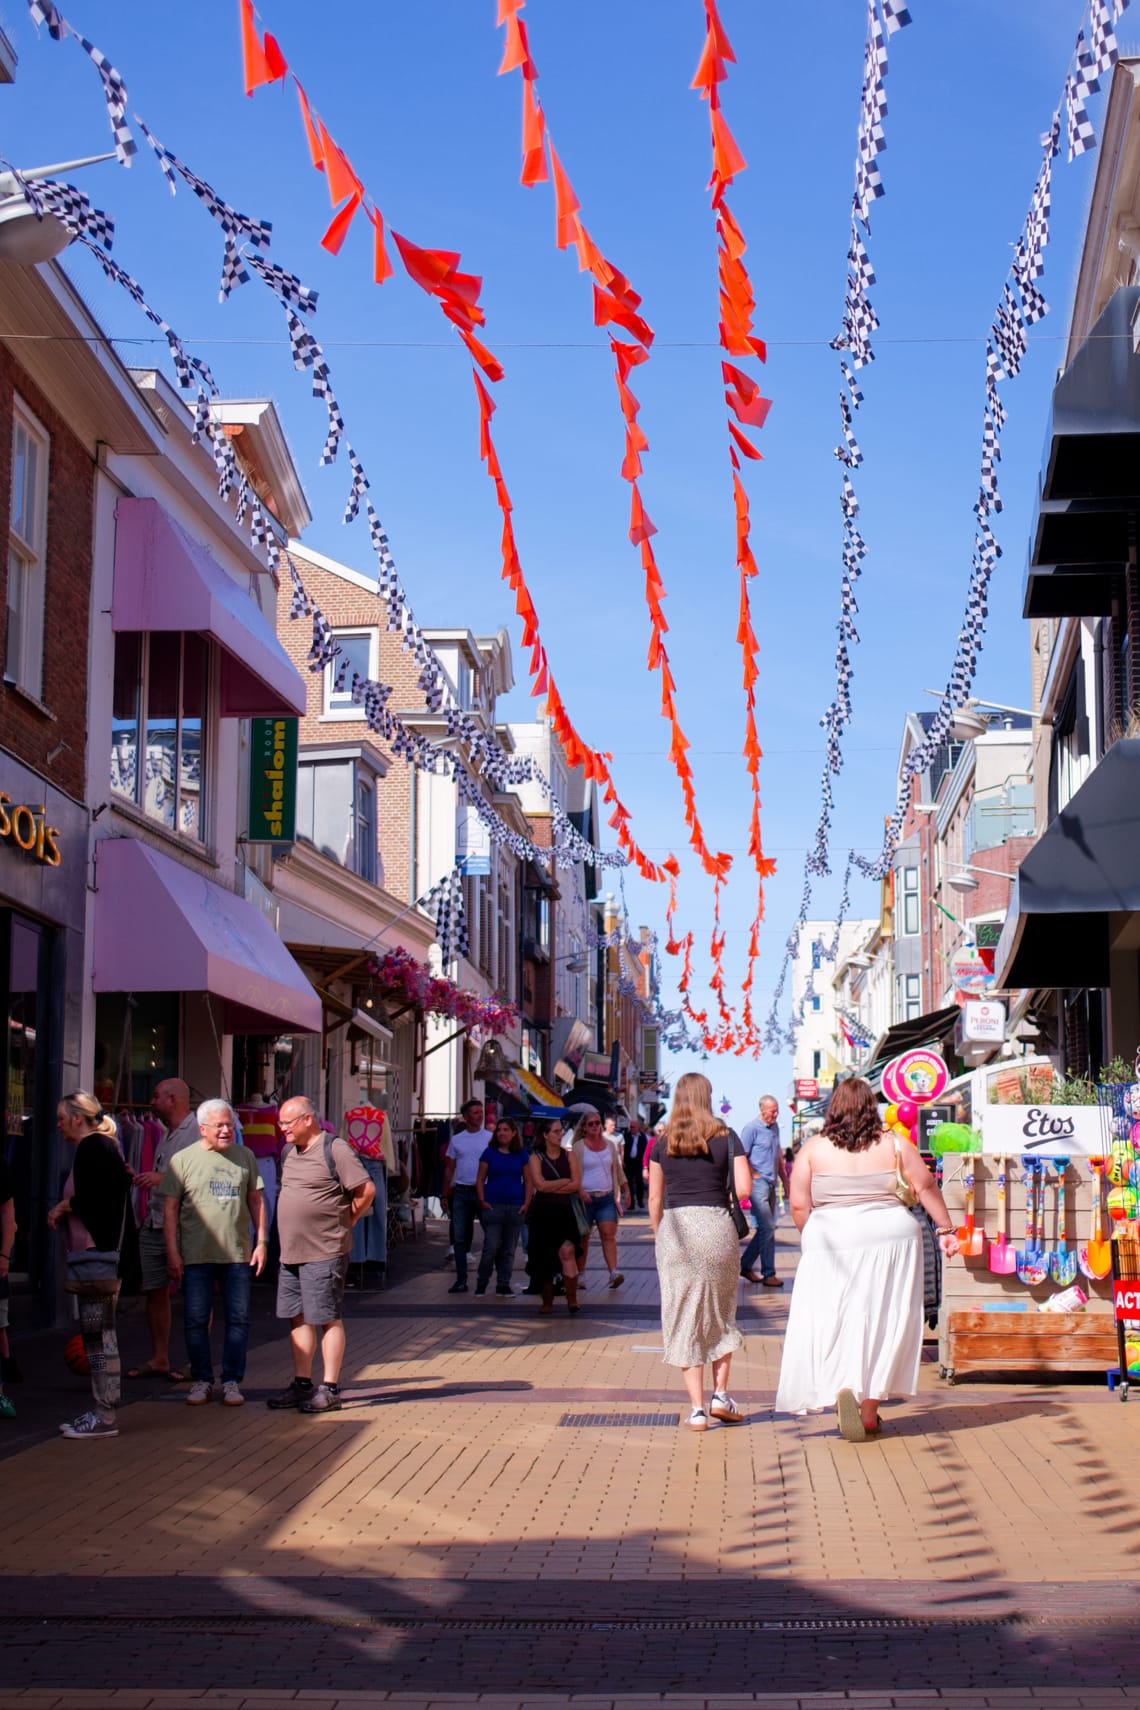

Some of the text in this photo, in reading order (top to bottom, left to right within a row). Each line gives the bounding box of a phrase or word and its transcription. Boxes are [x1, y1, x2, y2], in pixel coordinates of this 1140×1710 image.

[264, 721, 286, 836] shalom
[344, 1106, 385, 1124] LOVE
[1023, 1109, 1075, 1137] Etos
[1116, 1291, 1140, 1309] ACT
